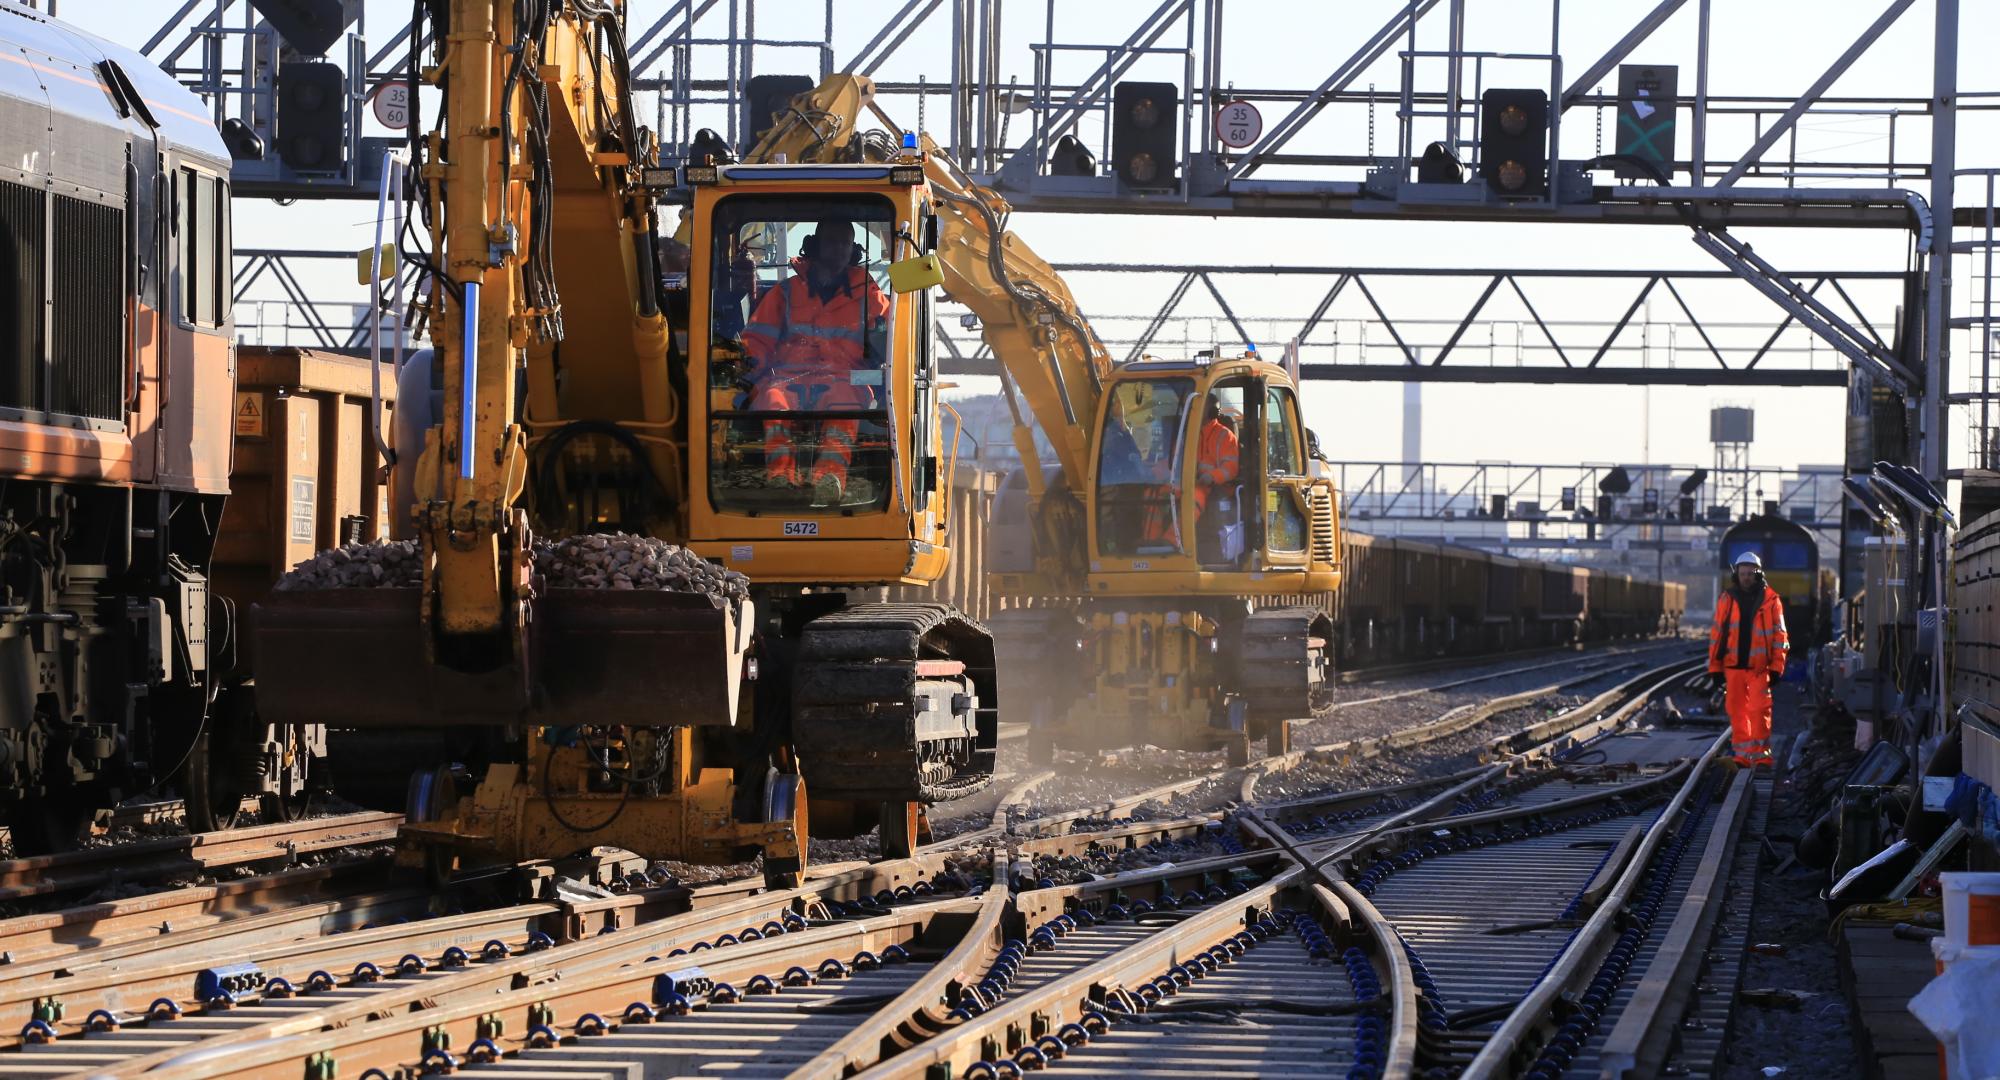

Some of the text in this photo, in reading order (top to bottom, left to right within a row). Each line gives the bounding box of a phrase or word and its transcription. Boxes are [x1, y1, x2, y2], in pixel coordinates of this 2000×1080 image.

[391, 89, 405, 102] 35
[387, 110, 403, 122] 60
[1232, 108, 1247, 120] 35
[1231, 129, 1247, 141] 60
[784, 522, 817, 535] 5472
